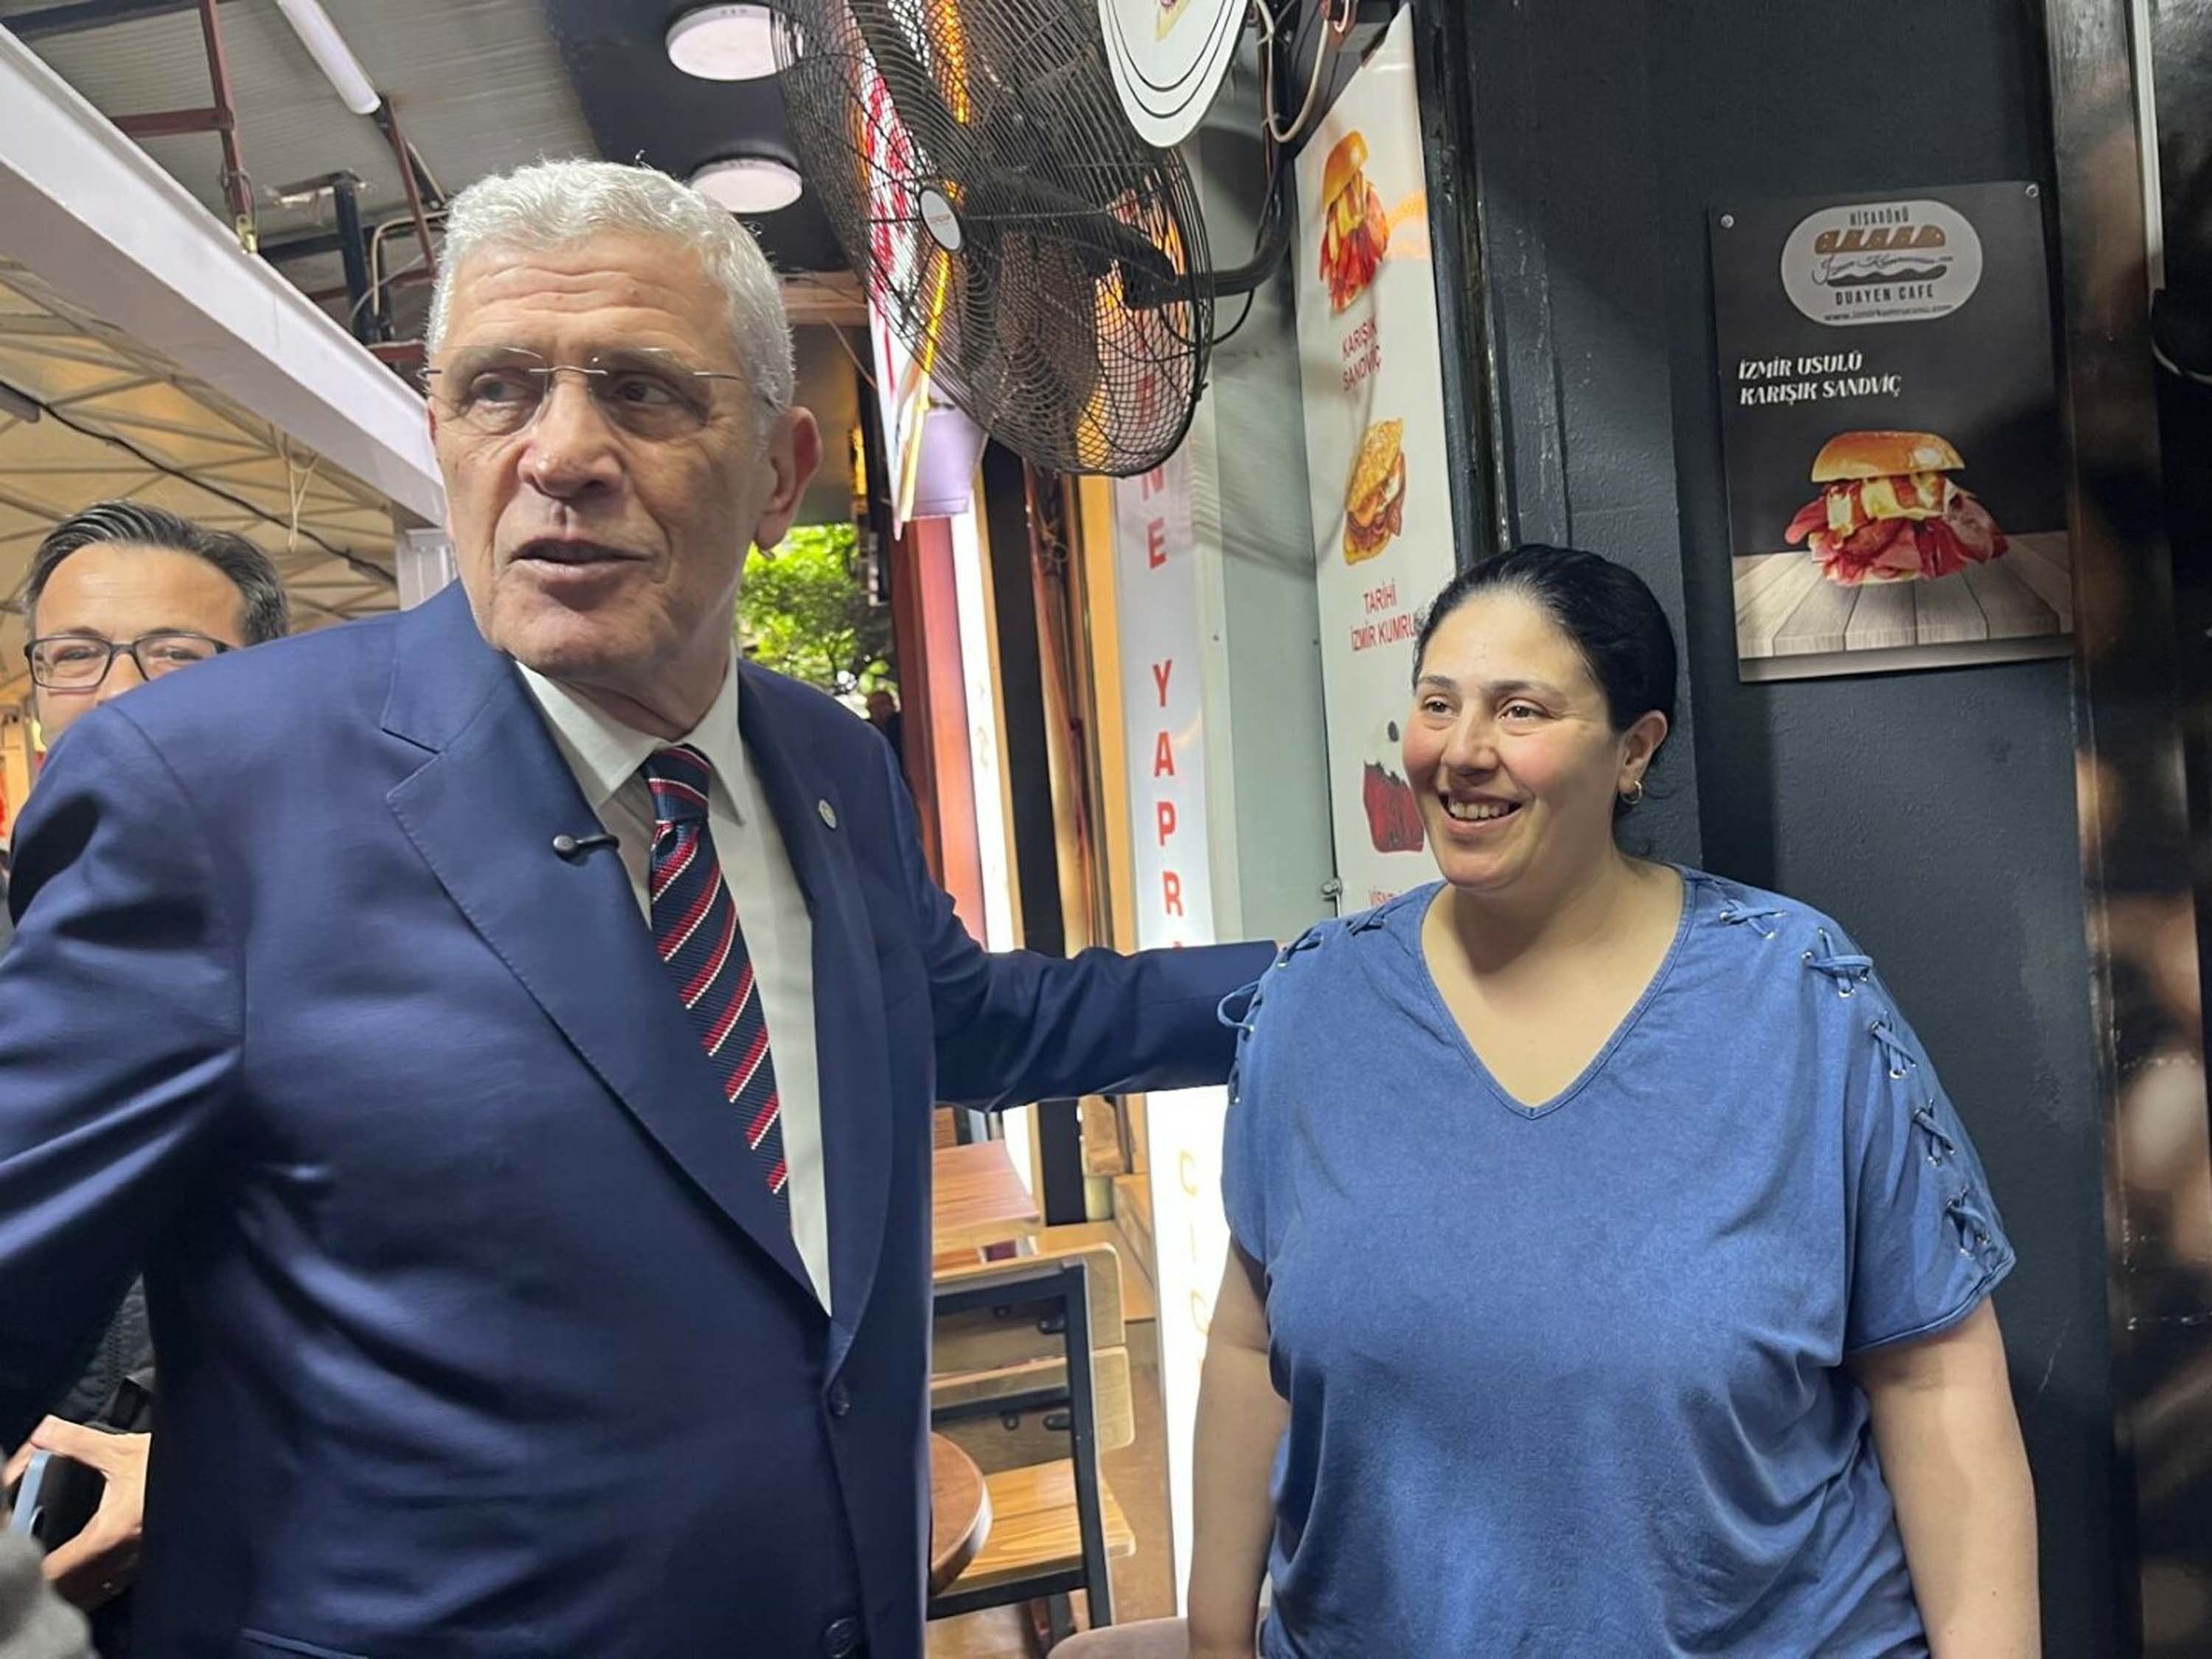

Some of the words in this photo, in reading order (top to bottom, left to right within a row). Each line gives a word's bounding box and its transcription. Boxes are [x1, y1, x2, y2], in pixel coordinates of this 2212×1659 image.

[1899, 284, 1934, 300] CAFE
[1739, 356, 1792, 380] İZMİR
[1741, 382, 1818, 406] KARIŞIK
[1823, 372, 1902, 397] SANDVİÇ
[1363, 578, 1397, 615] TARİHİ
[1350, 621, 1377, 651] İZMİR
[1152, 659, 1183, 949] YAPR
